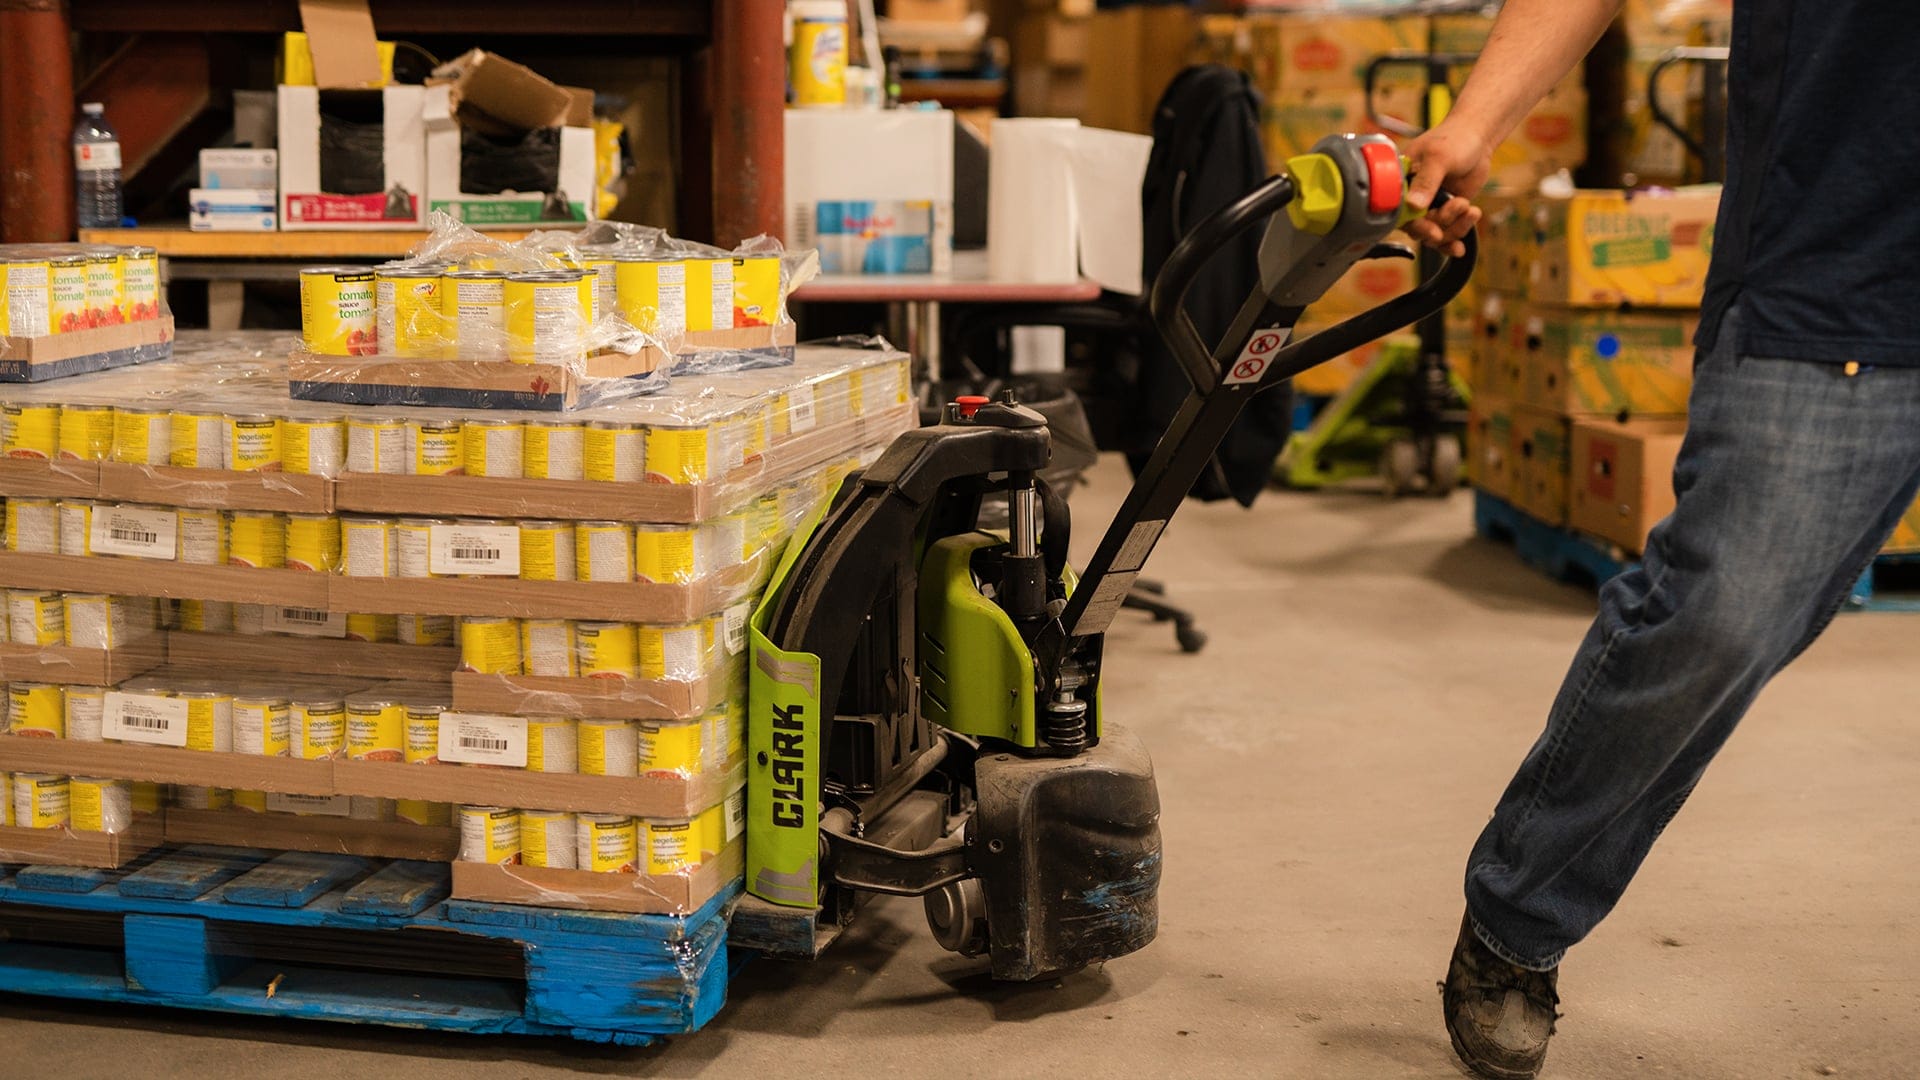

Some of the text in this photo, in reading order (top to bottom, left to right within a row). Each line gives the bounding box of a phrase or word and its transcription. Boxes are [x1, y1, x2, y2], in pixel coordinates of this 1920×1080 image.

[88, 271, 114, 281] mato
[88, 287, 114, 297] mate
[338, 290, 374, 301] tomato
[237, 432, 273, 441] vegetable
[309, 720, 343, 729] vegetable
[772, 703, 804, 828] CLARK
[597, 832, 632, 844] vegetable
[652, 836, 688, 845] vegetable
